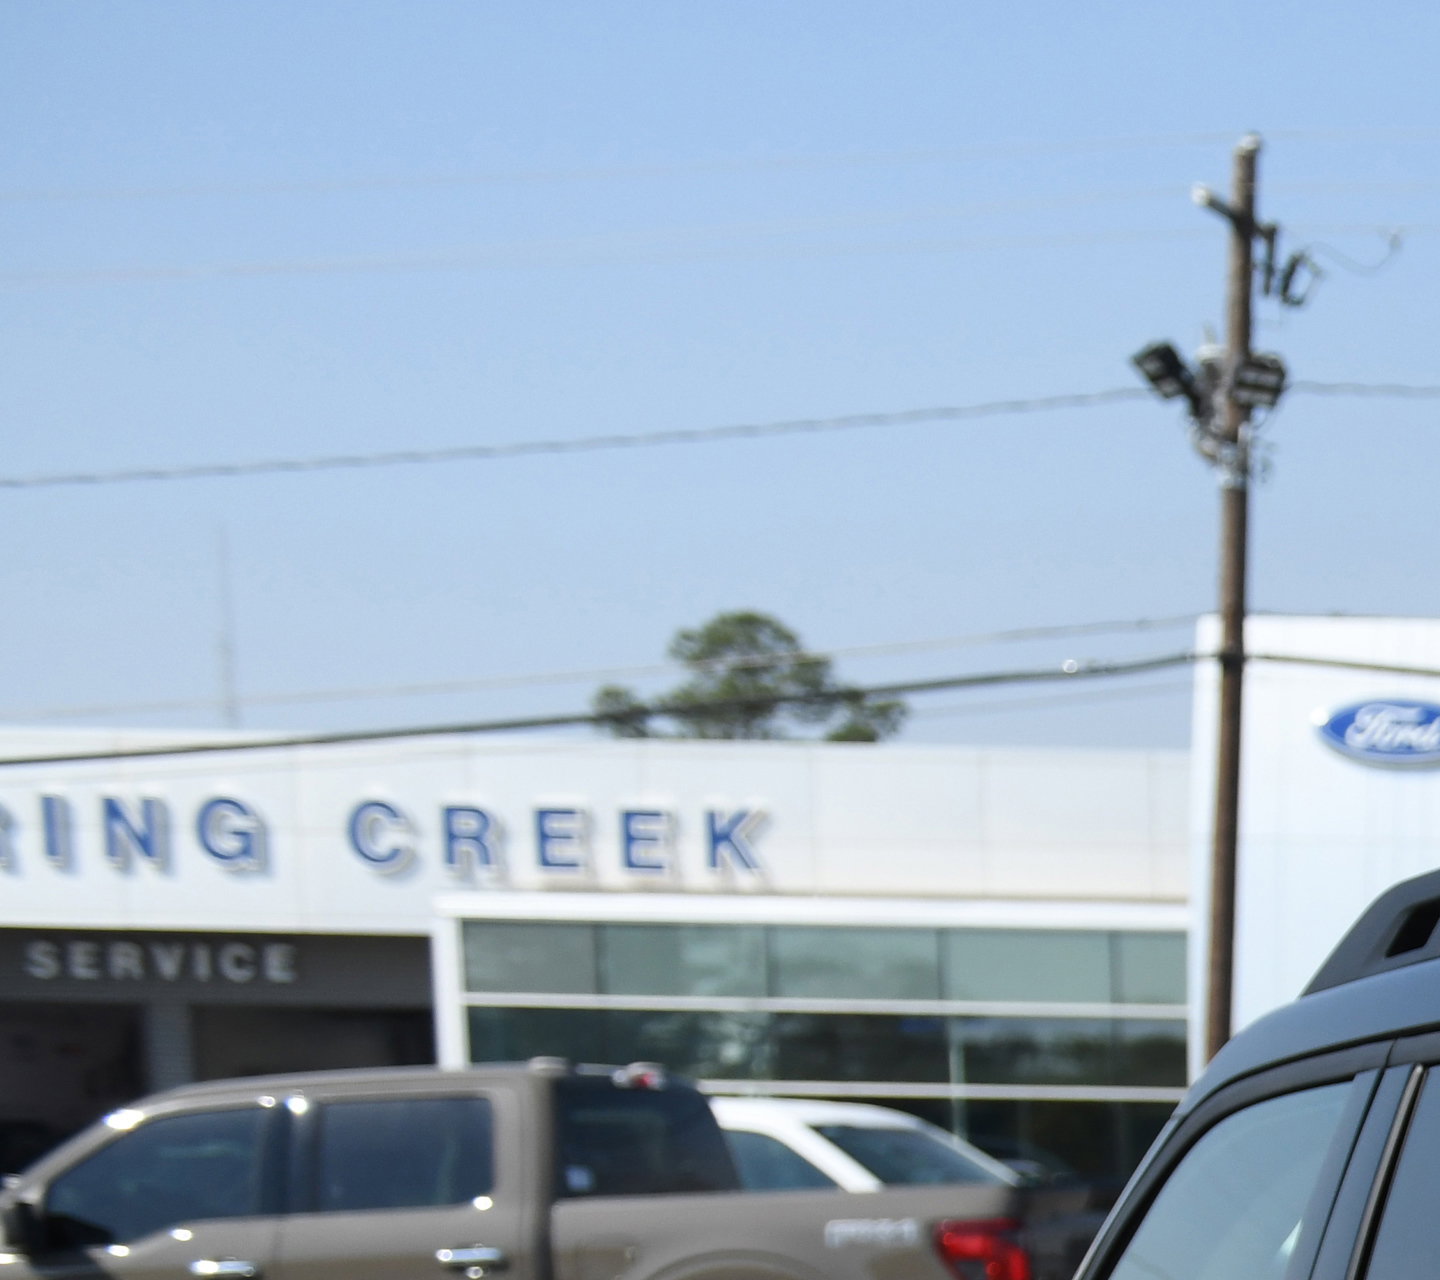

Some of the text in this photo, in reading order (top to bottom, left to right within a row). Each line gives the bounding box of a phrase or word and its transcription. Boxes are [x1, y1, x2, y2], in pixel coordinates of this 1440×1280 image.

[0, 796, 762, 870] ING CREEK
[25, 940, 297, 982] SERVICE
